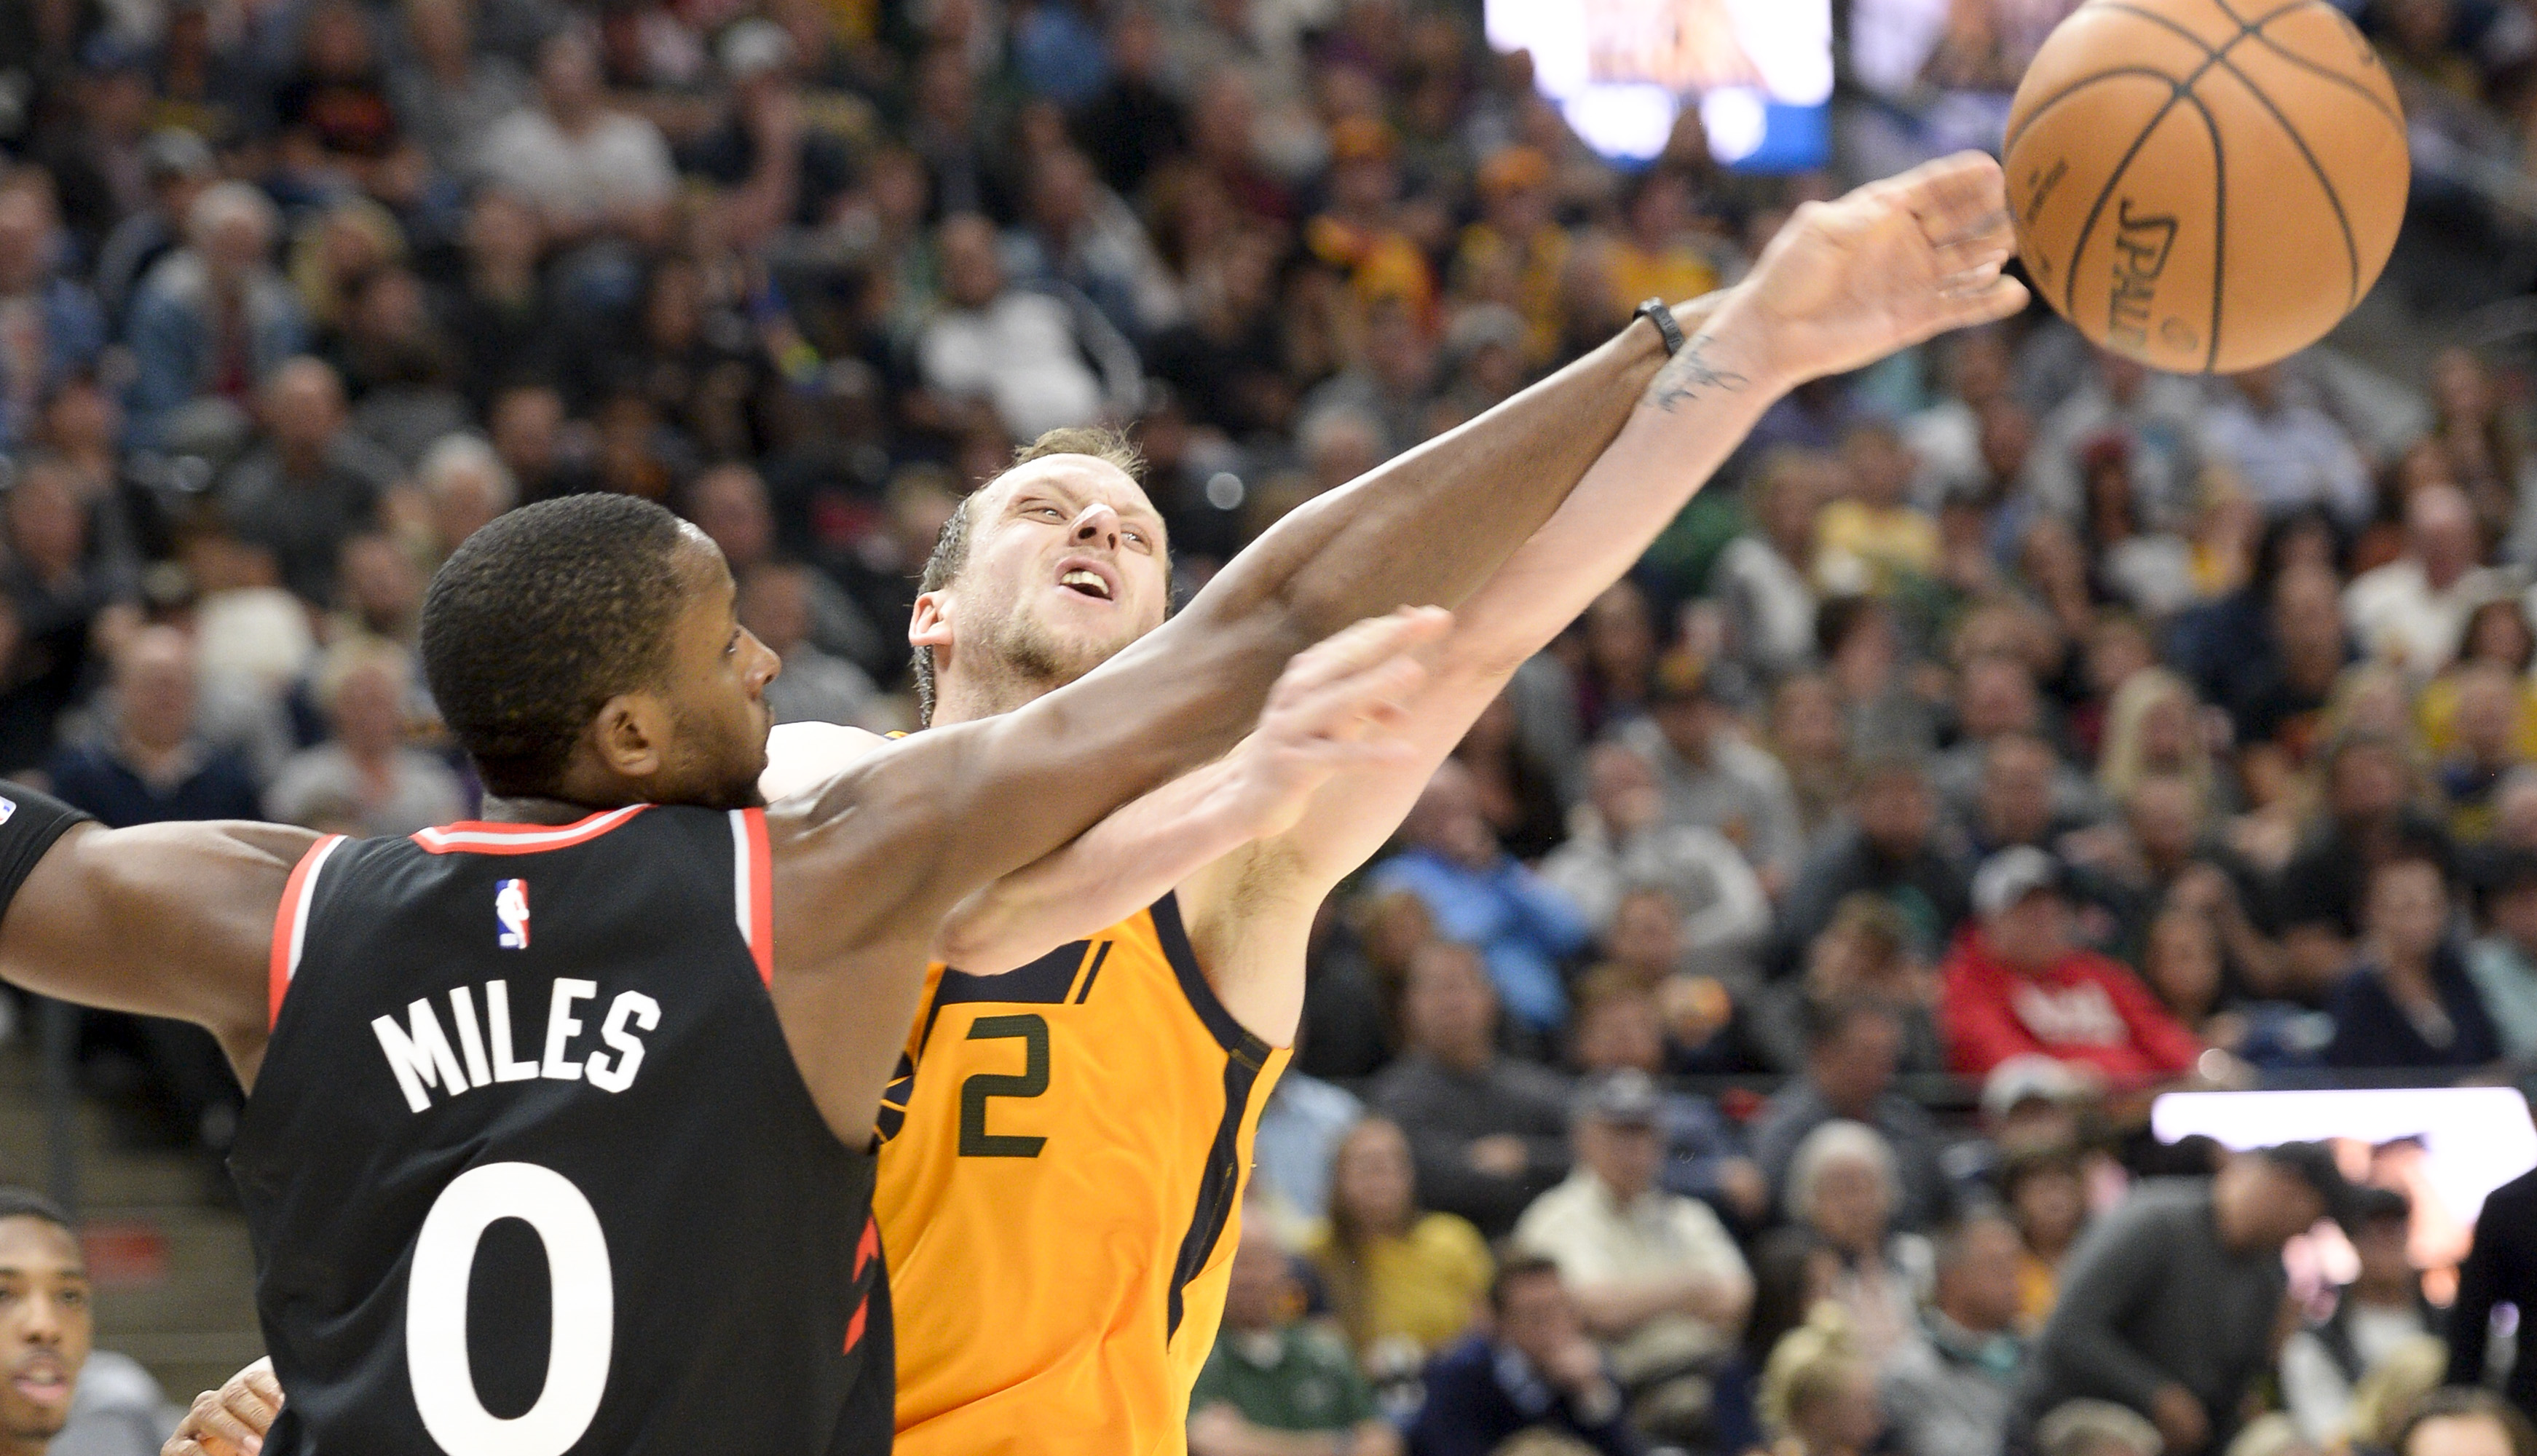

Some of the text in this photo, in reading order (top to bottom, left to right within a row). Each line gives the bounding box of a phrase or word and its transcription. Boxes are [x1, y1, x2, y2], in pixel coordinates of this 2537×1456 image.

[371, 978, 662, 1113] MILES
[958, 1013, 1050, 1158] 2
[406, 1161, 614, 1456] 0
